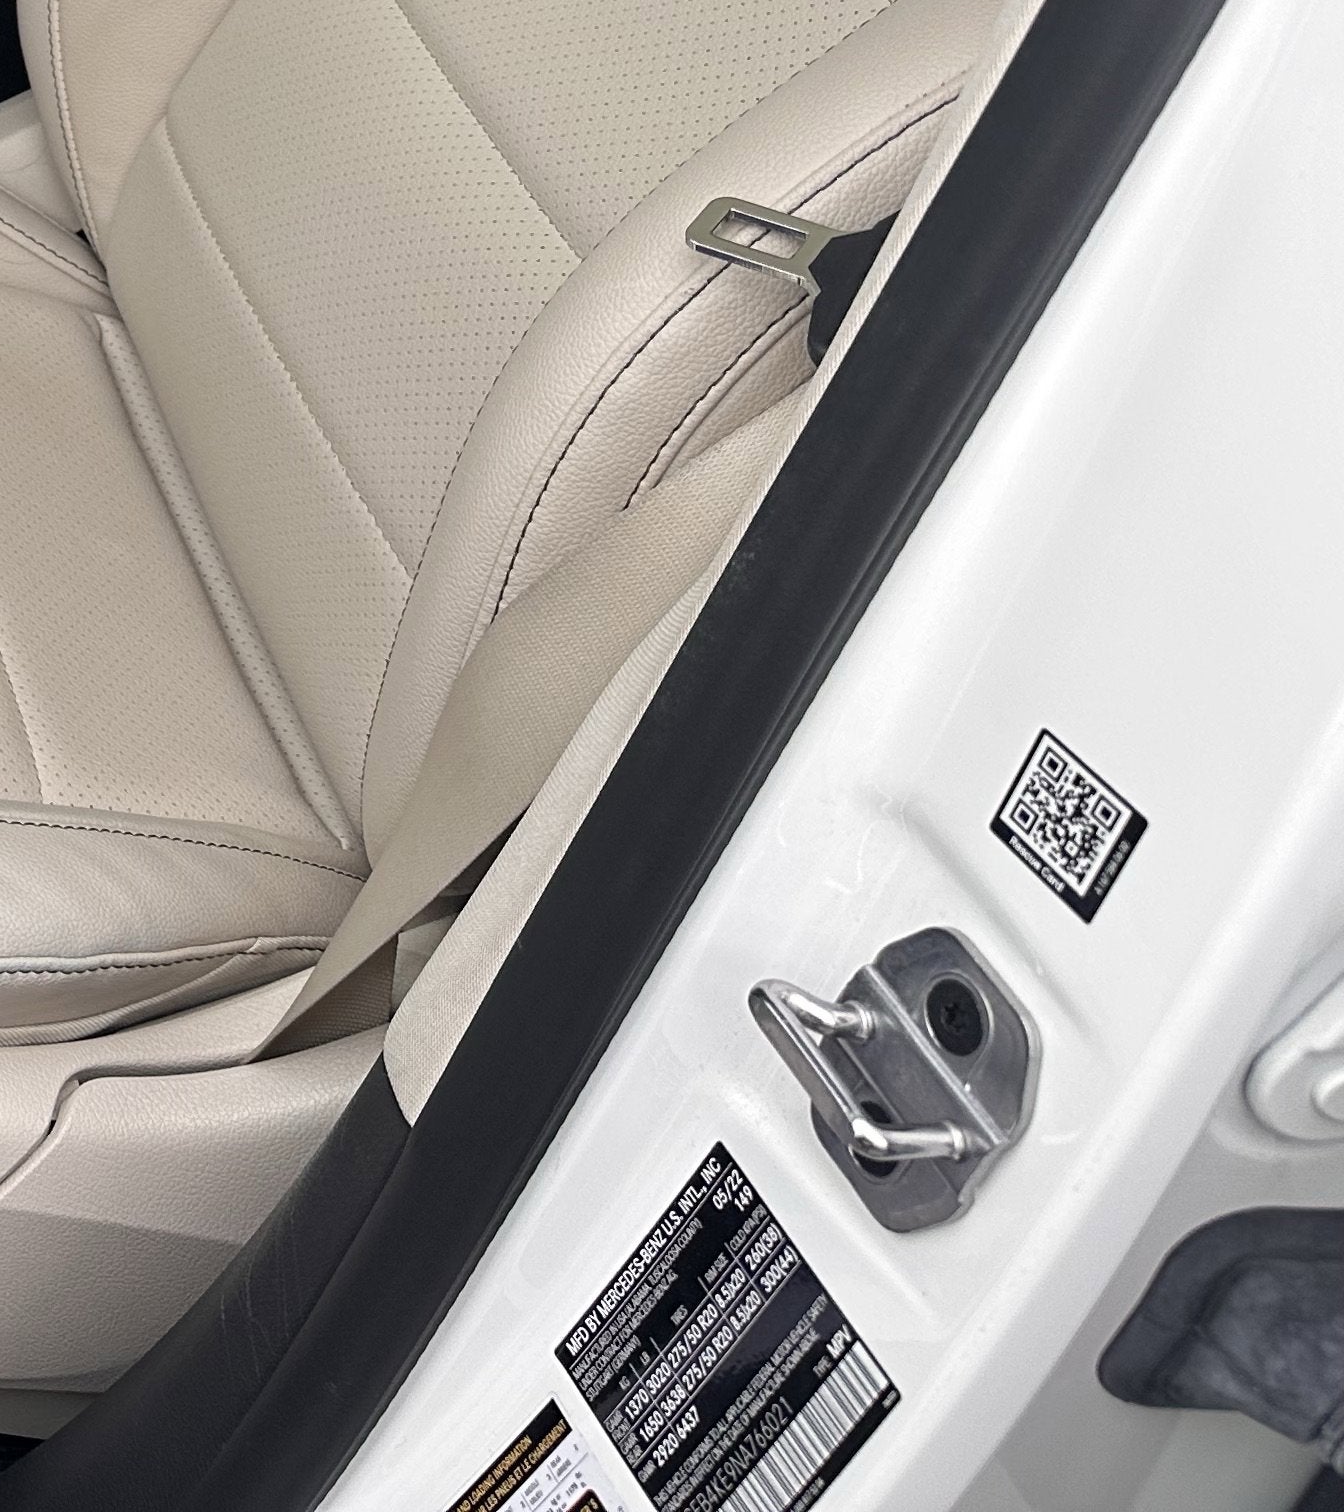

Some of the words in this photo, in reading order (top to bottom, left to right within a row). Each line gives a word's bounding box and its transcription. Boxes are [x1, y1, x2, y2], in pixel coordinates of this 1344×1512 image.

[1009, 835, 1042, 871] Rescue
[1041, 866, 1065, 892] Card
[712, 1169, 743, 1210] 05/22
[734, 1185, 753, 1212] 149
[565, 1326, 590, 1356] MFD
[584, 1310, 601, 1333] BY
[597, 1229, 667, 1318] MERCEDES-BENZ
[660, 1210, 684, 1236] U.S.
[700, 1157, 721, 1185] INC
[625, 1388, 650, 1420] 1370
[645, 1362, 672, 1395] 3020
[667, 1324, 702, 1369] 275/50
[696, 1303, 718, 1331] R20
[745, 1223, 783, 1271] 260(38)
[639, 1410, 664, 1442] 1650
[660, 1384, 687, 1417] 3638
[682, 1346, 717, 1391] 275/50
[711, 1325, 733, 1353] R20
[760, 1245, 799, 1293] 300(44)
[826, 1324, 852, 1359] MPV
[652, 1433, 679, 1467] 2920
[676, 1405, 700, 1439] 6437
